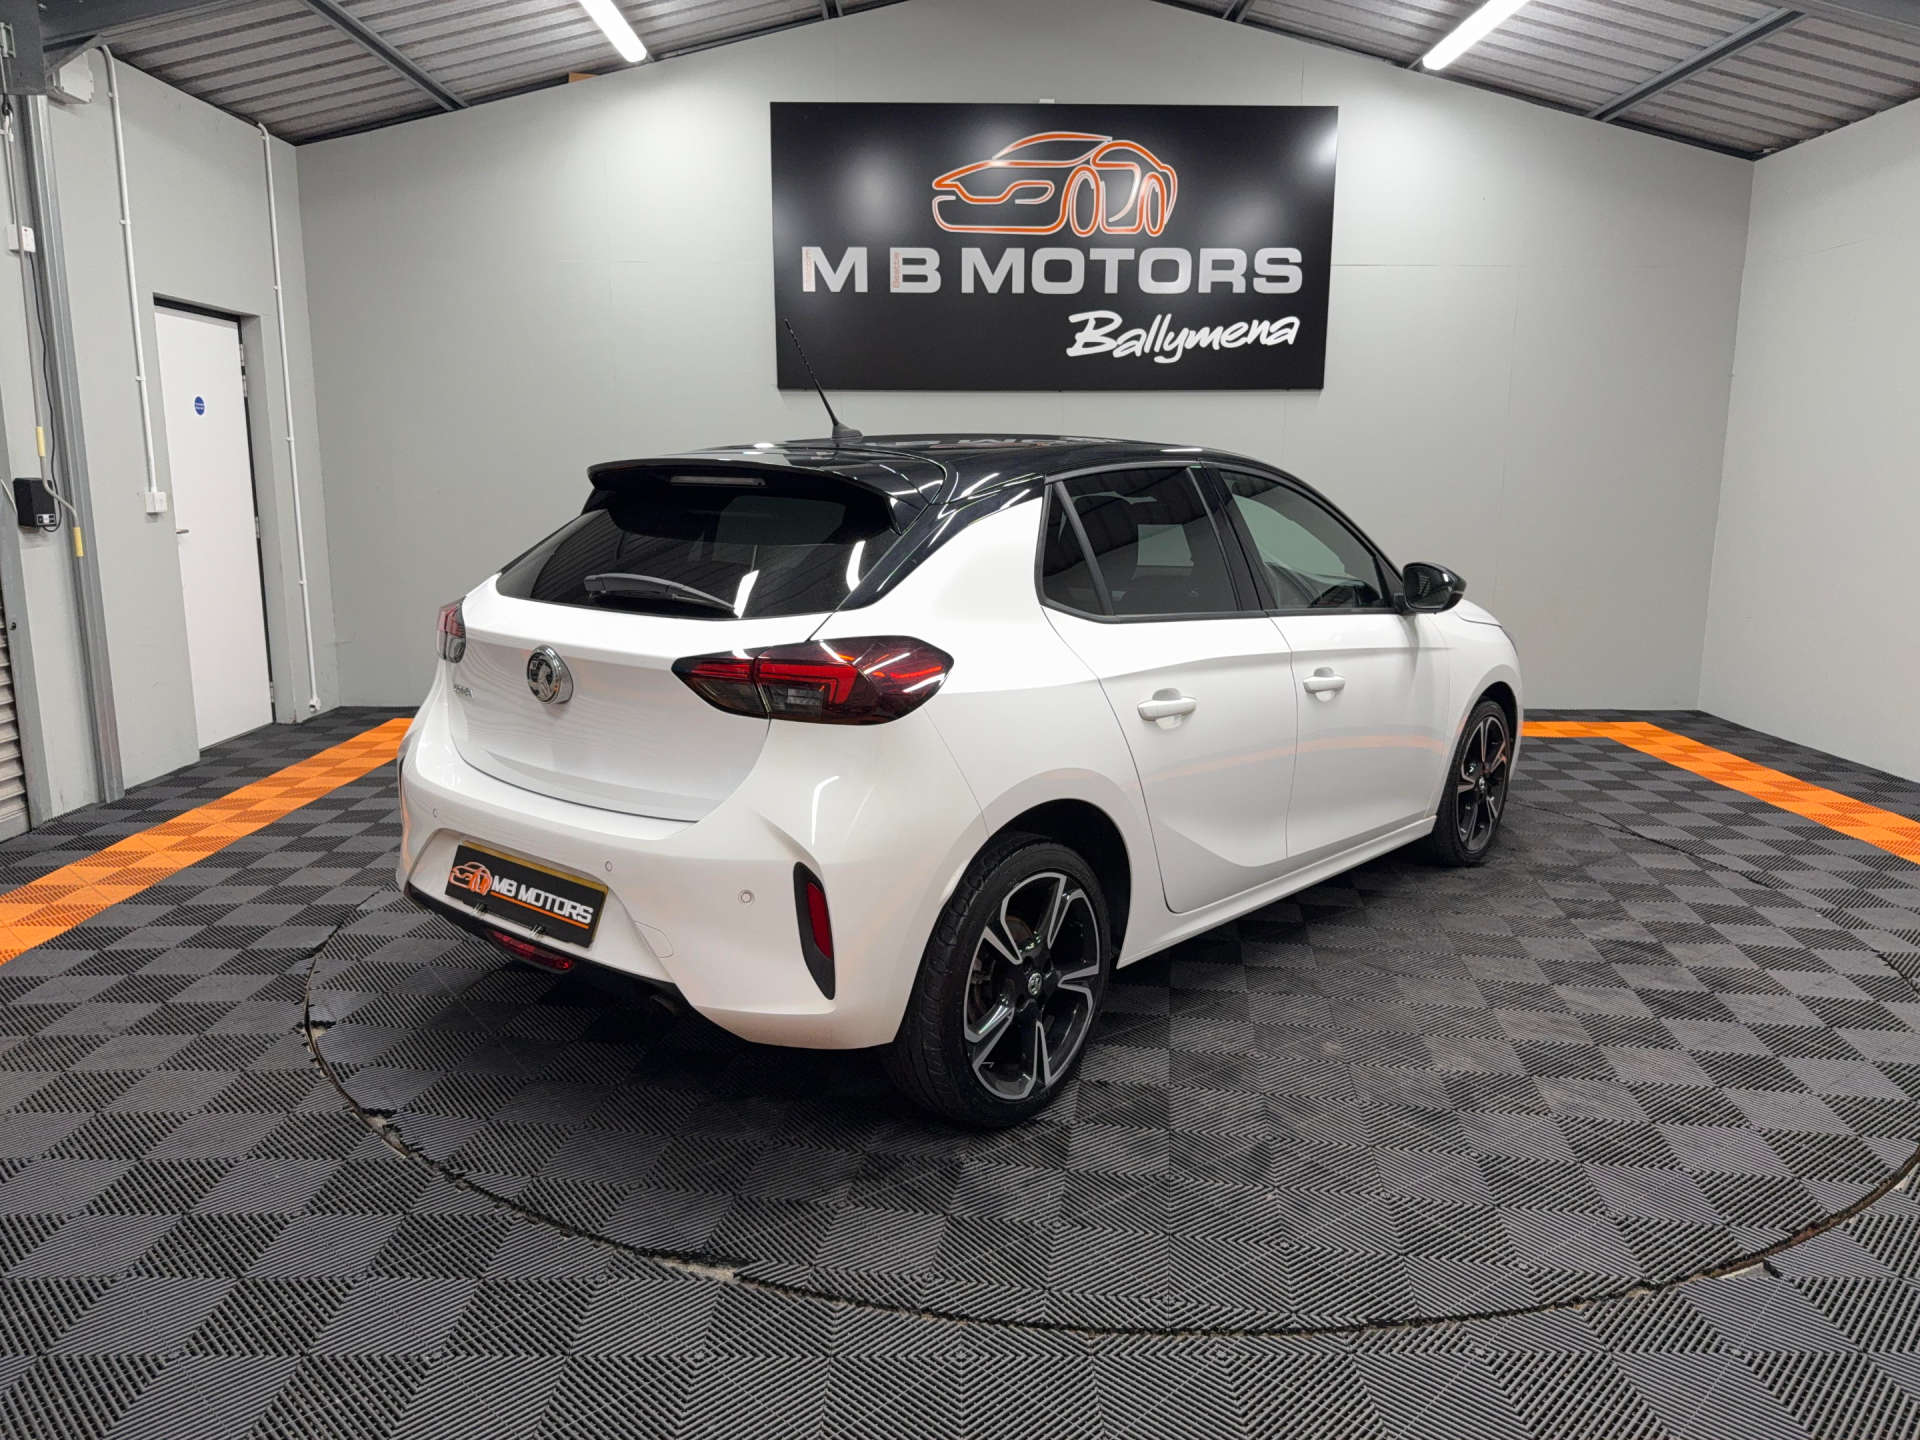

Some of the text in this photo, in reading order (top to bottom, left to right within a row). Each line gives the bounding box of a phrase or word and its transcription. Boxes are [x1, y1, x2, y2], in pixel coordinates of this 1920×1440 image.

[961, 247, 1303, 294] MOTORS
[1066, 311, 1300, 363] Ballymena
[492, 876, 594, 924] MB MOTORS
